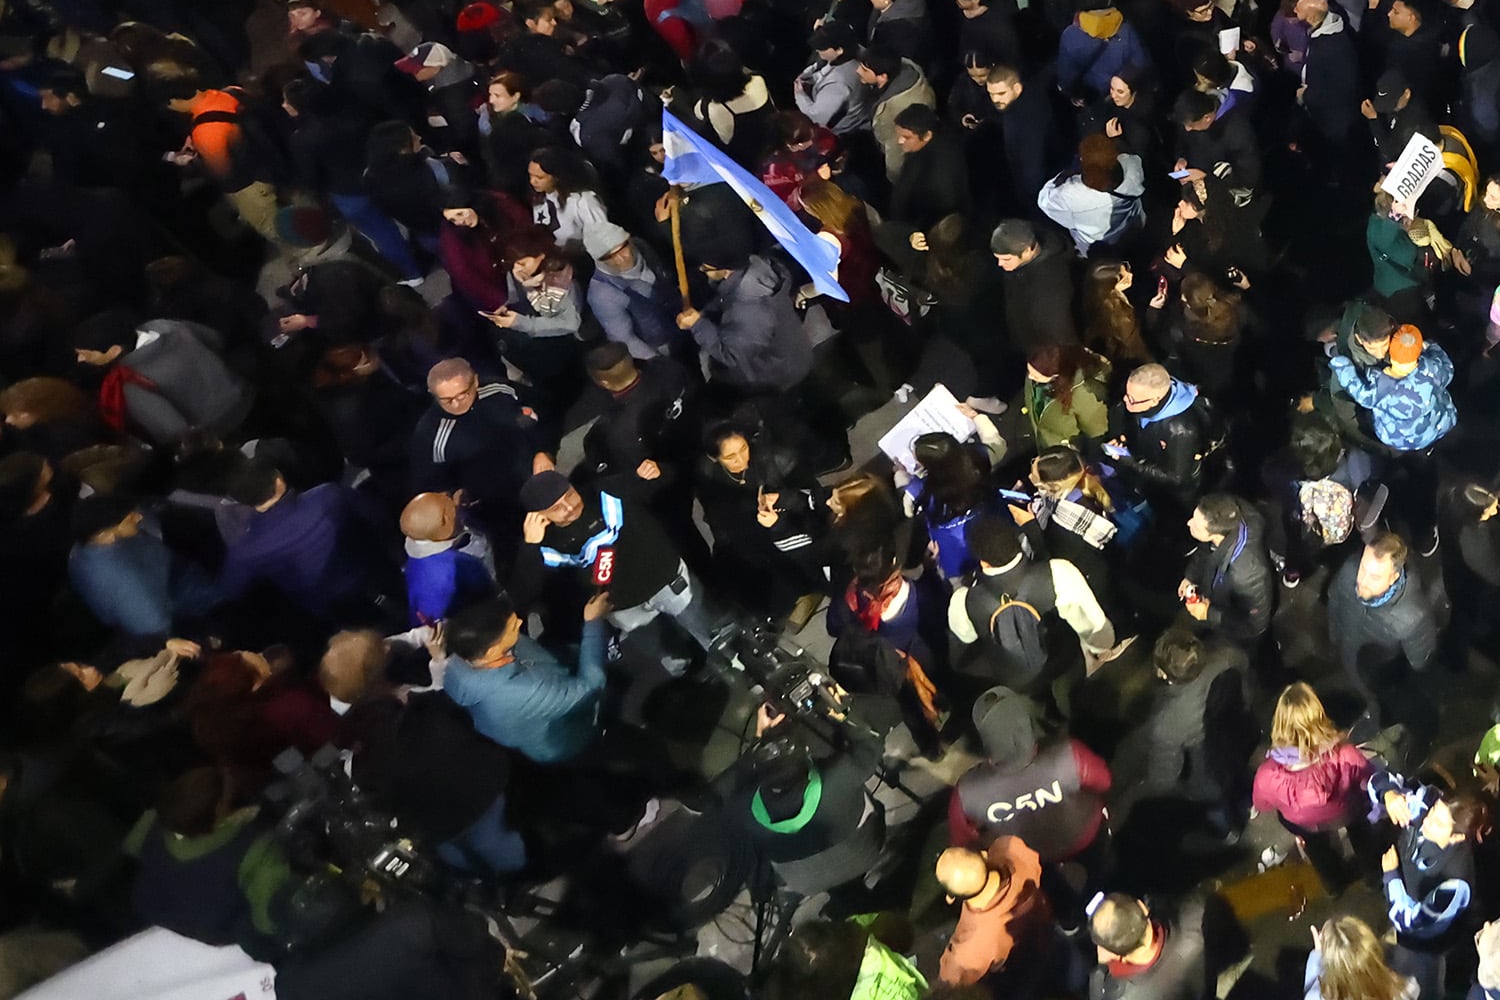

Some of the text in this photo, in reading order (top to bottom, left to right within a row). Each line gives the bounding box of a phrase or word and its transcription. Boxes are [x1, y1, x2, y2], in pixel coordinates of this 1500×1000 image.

[1397, 145, 1436, 199] GRACIAS
[597, 551, 614, 582] C5N
[986, 780, 1063, 824] C5N
